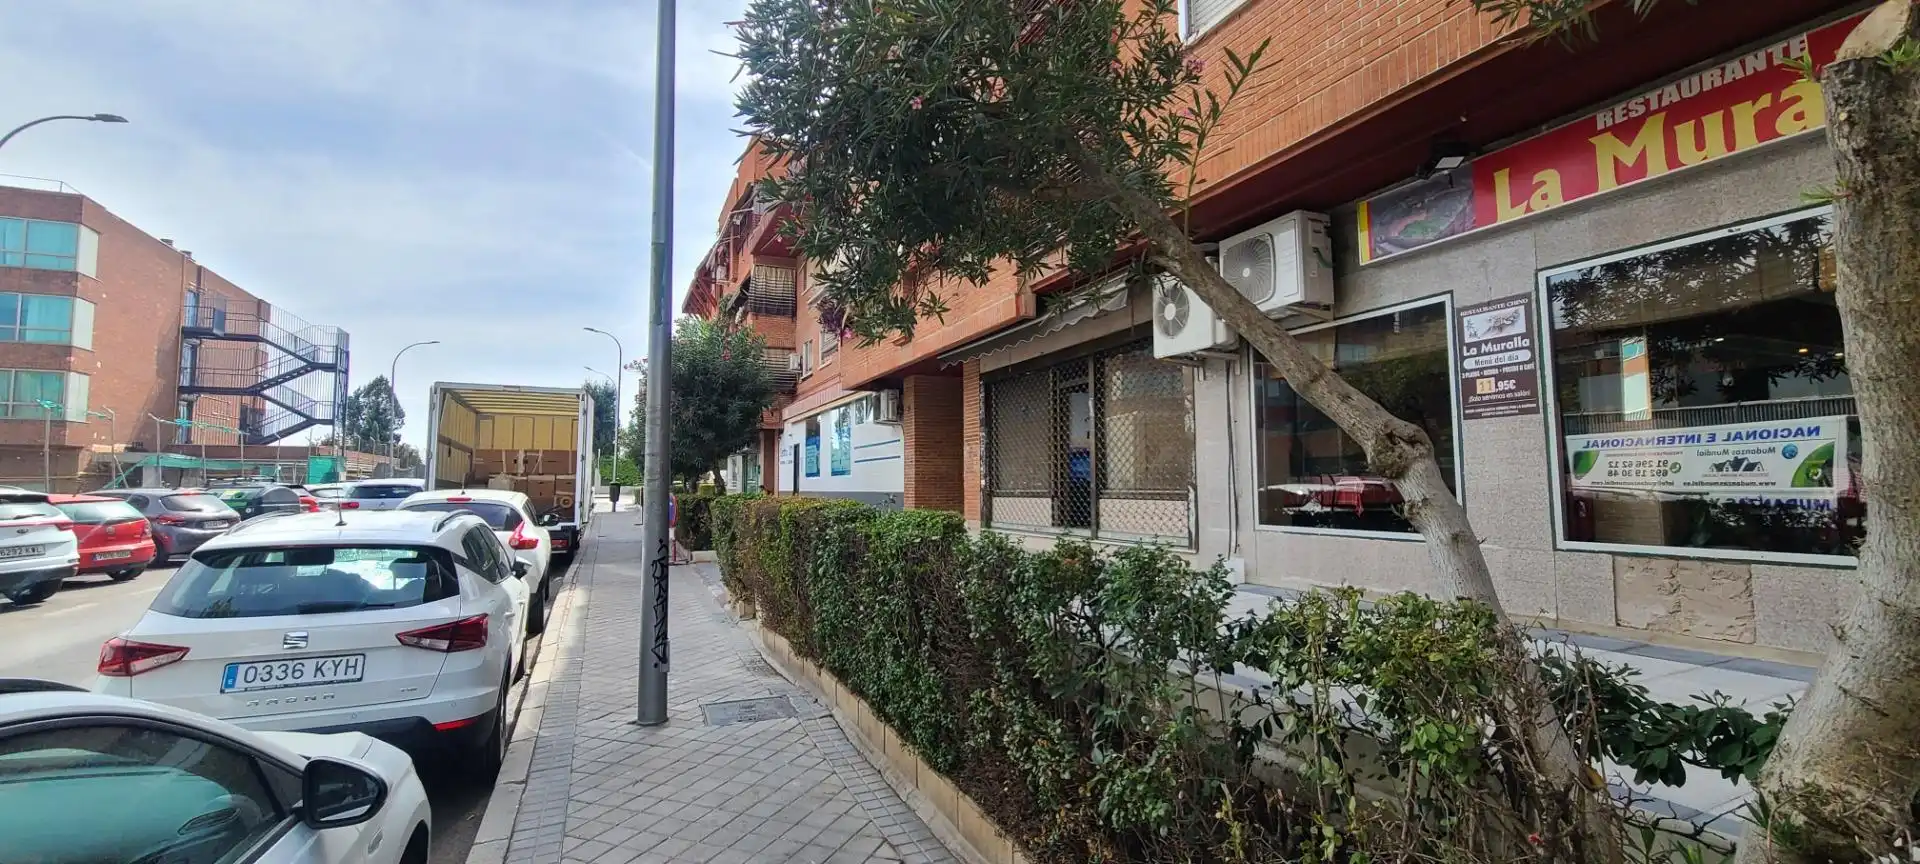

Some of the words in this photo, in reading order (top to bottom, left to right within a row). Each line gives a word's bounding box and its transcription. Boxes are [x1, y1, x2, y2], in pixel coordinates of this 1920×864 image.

[1597, 33, 1809, 130] RESTAURANTE
[1494, 167, 1564, 223] La
[1463, 345, 1478, 357] La
[1481, 336, 1530, 354] Muralla
[1474, 357, 1494, 366] Menú
[1494, 354, 1506, 363] del
[243, 662, 306, 684] 0336
[313, 657, 359, 678] KYH
